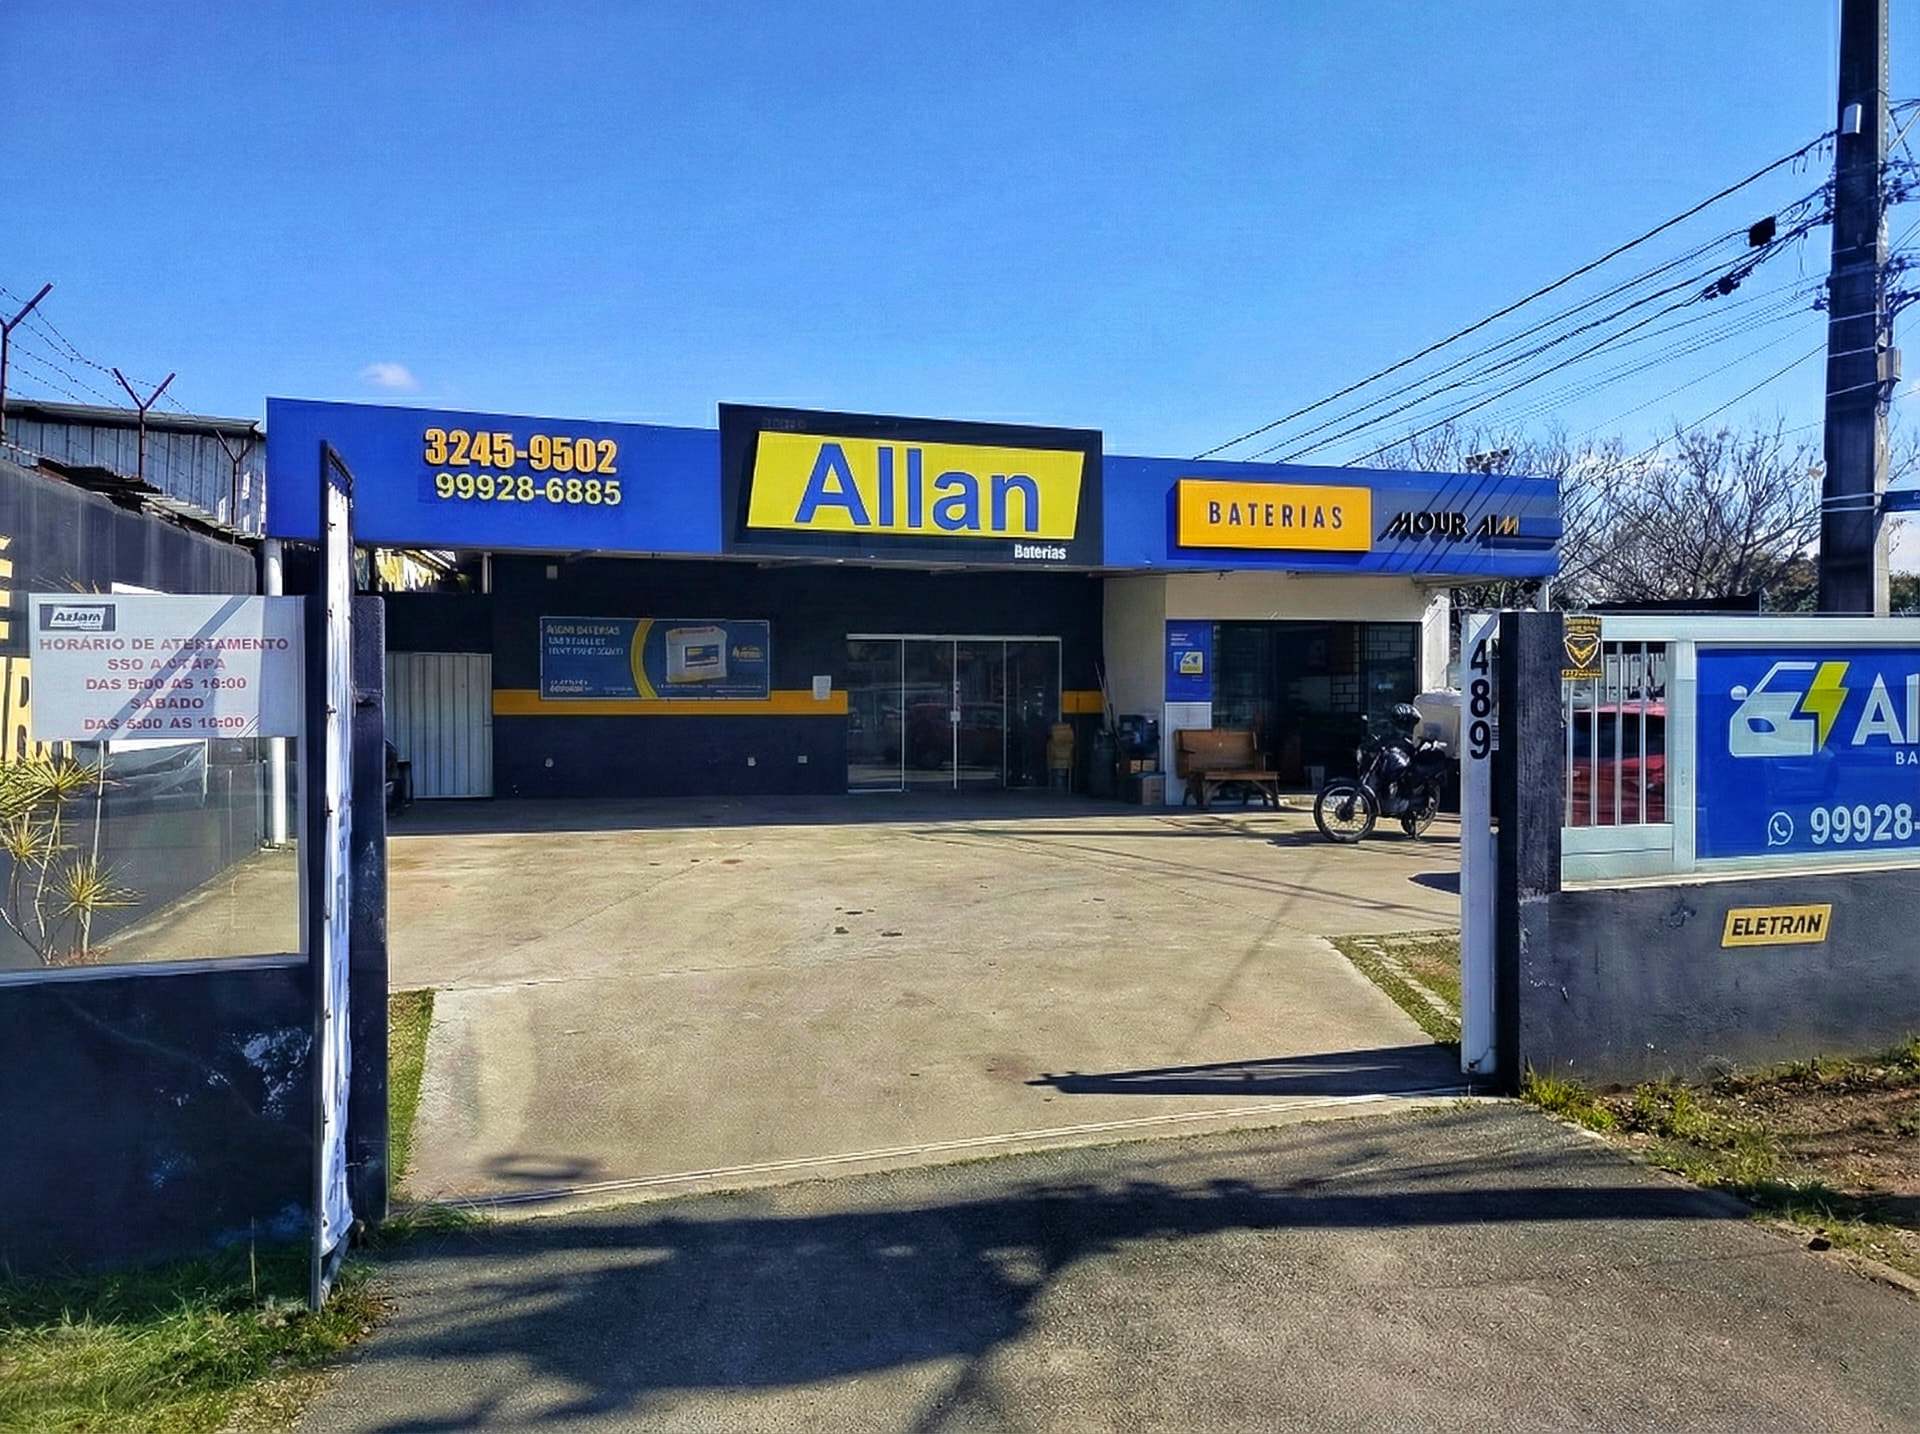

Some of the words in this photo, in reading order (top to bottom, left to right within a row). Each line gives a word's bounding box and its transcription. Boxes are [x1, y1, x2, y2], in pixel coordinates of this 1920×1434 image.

[424, 428, 618, 474] 3245-9502
[435, 472, 622, 506] 99928-6885
[794, 442, 1040, 532] Allan
[1208, 501, 1343, 530] BATERIAS
[1014, 544, 1067, 560] Baterias
[39, 634, 126, 651] HORÁRIO
[131, 638, 155, 650] DE
[86, 678, 122, 691] DAS
[1469, 639, 1491, 759] 489
[84, 718, 120, 731] DAS
[1895, 751, 1919, 765] BA
[1732, 914, 1823, 936] ELETRAN
